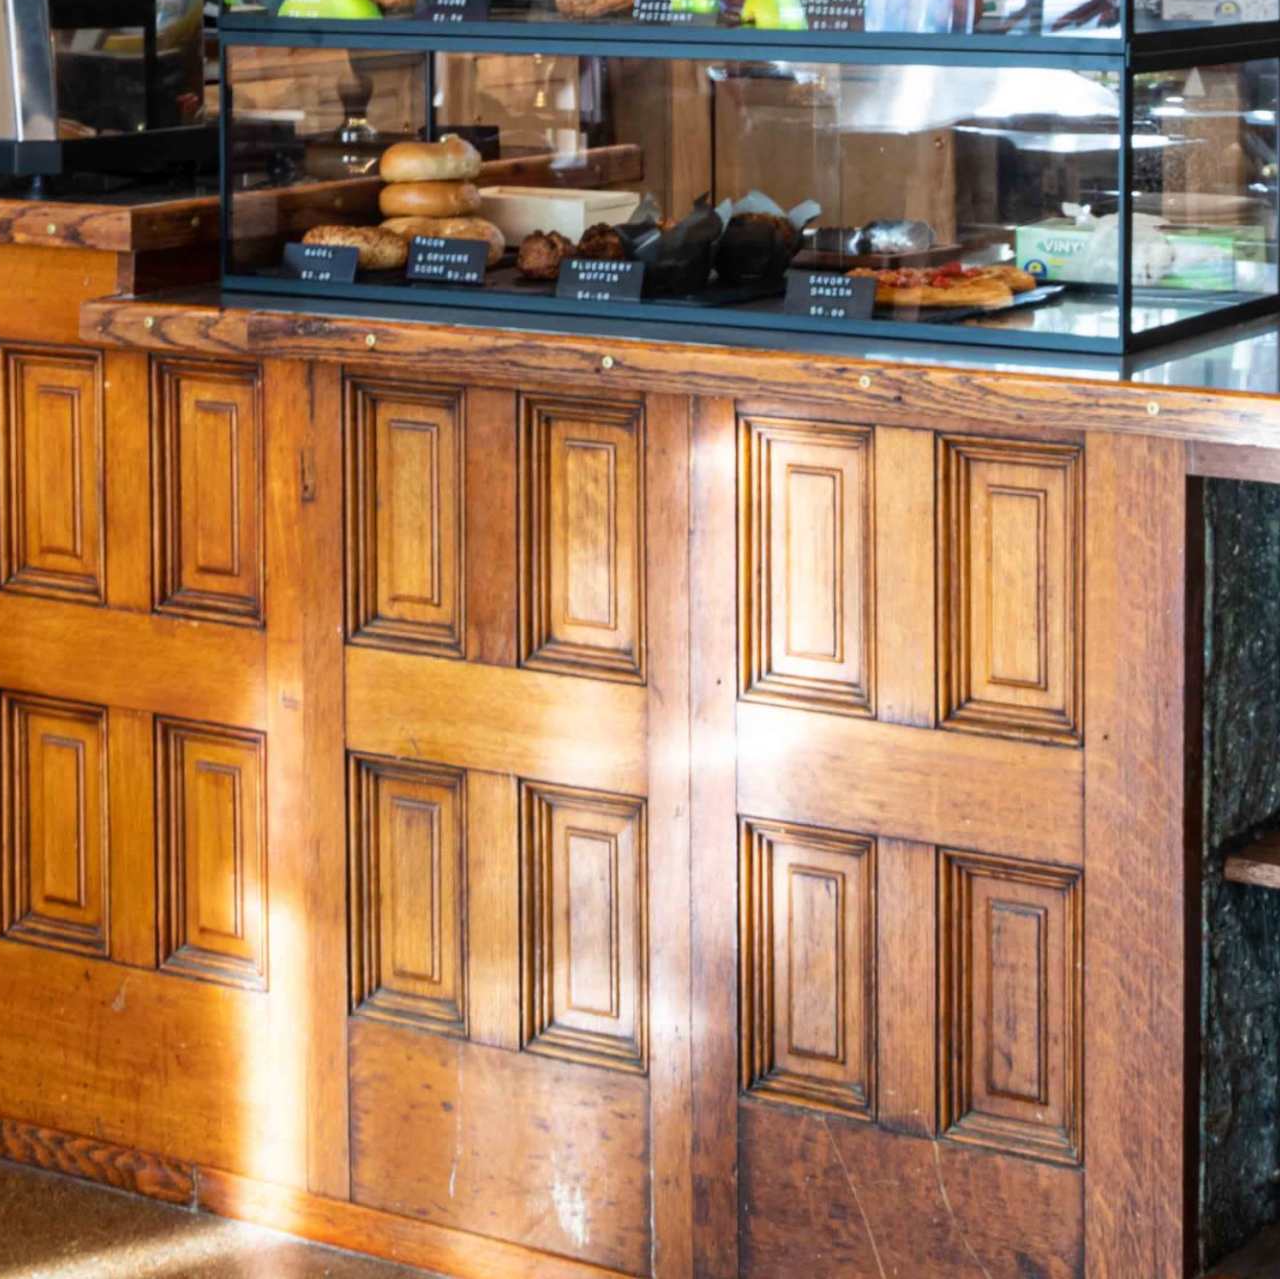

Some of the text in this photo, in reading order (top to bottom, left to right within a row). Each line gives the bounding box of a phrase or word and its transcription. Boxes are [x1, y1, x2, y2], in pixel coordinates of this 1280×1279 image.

[304, 248, 333, 259] BAGEL
[571, 260, 632, 272] BLUEBERRY
[578, 272, 619, 282] MUFFIN
[809, 275, 852, 286] SAVORY
[810, 286, 852, 296] DANISH
